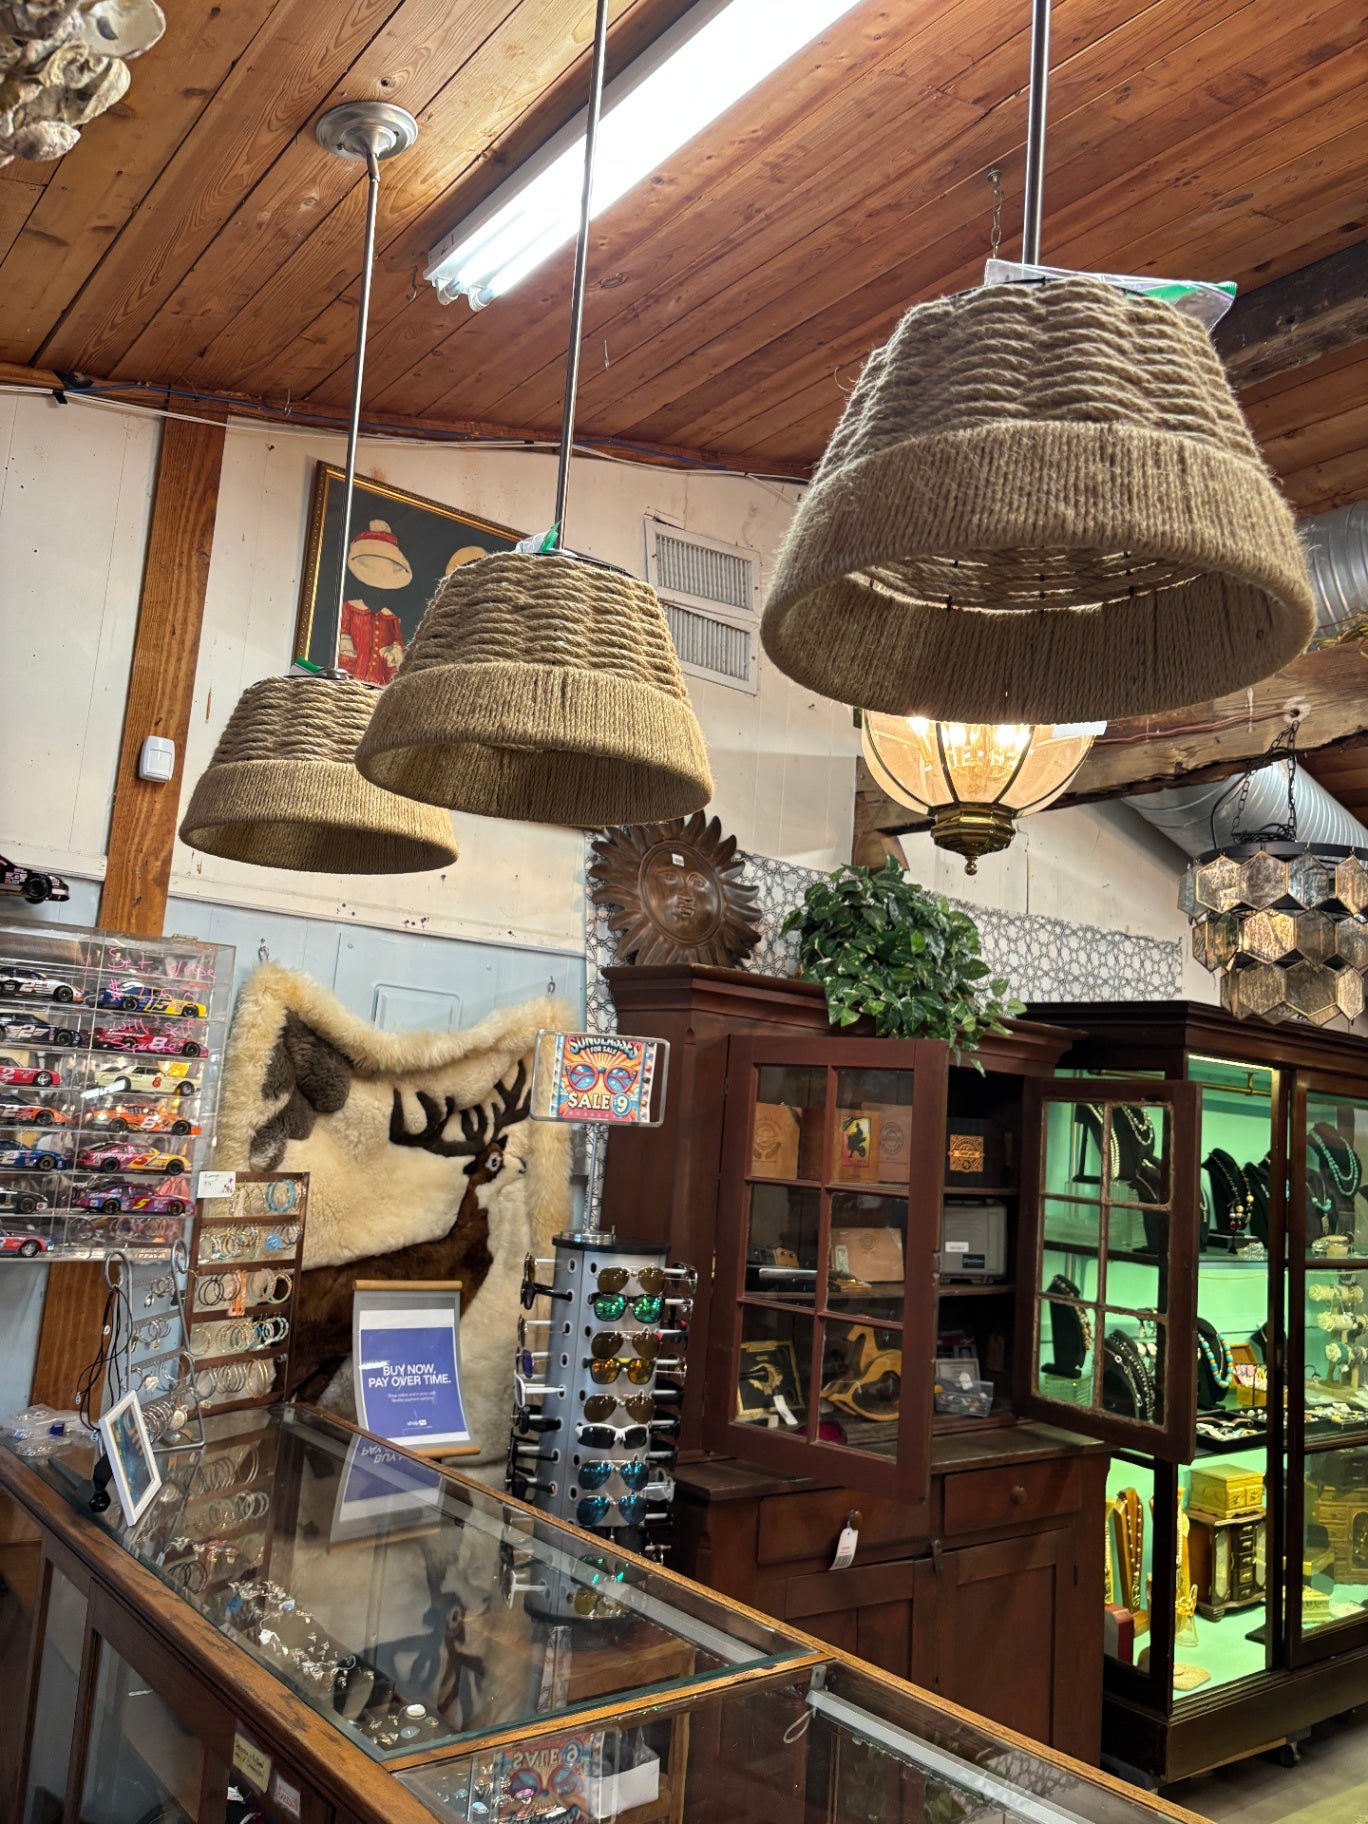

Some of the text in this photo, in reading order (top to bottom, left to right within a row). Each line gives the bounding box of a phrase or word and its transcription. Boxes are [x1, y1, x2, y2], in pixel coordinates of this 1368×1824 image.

[590, 1046, 618, 1055] FOR SALE
[383, 1363, 405, 1377] BUY
[368, 1373, 452, 1389] PAY OVER TIME.
